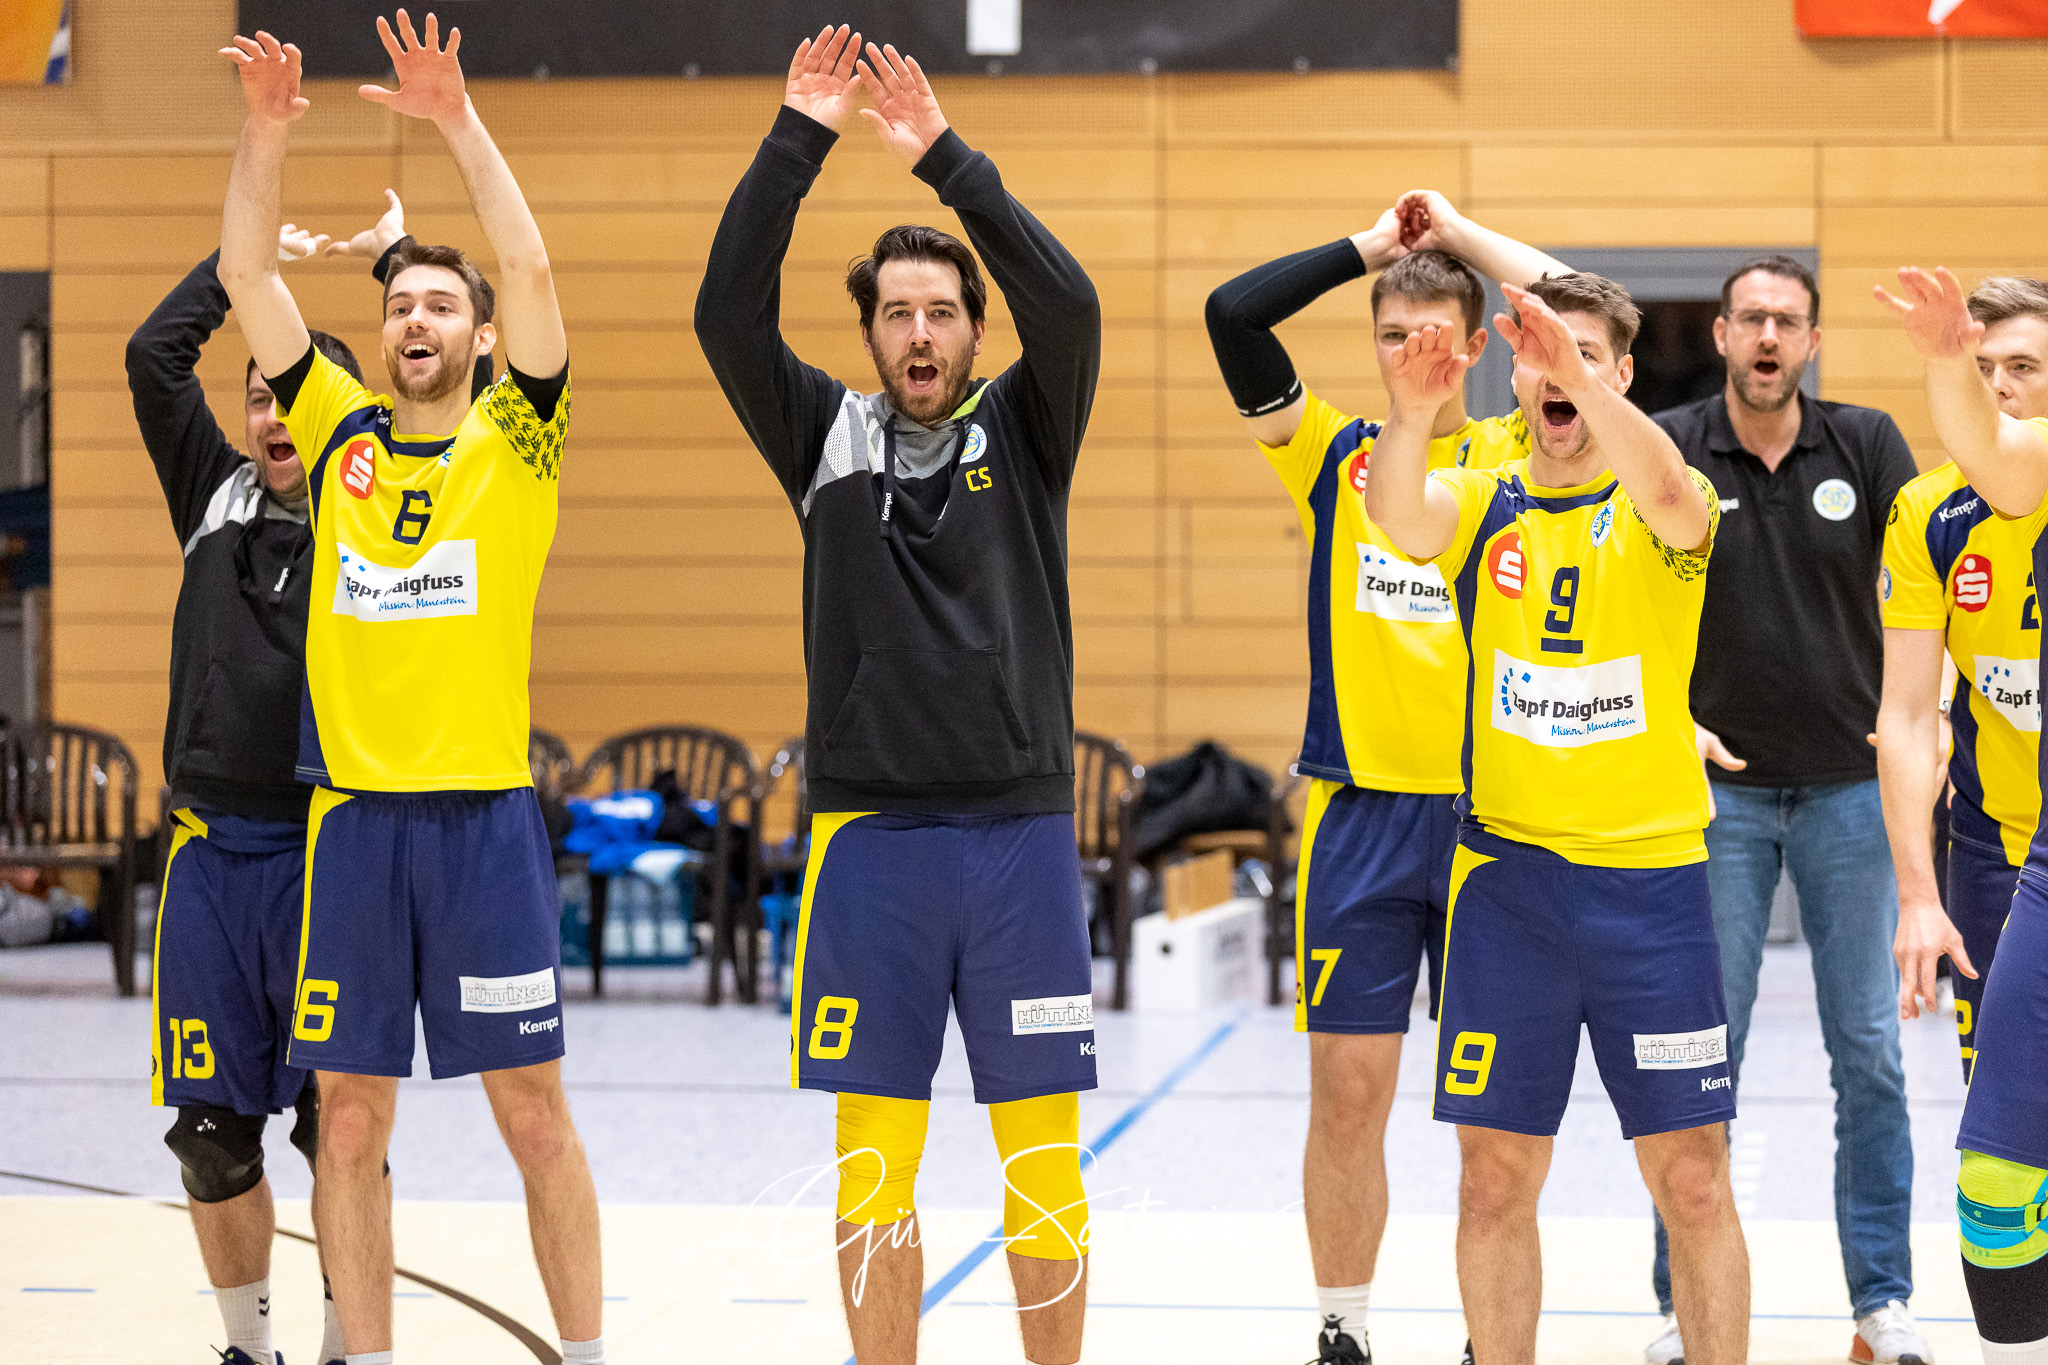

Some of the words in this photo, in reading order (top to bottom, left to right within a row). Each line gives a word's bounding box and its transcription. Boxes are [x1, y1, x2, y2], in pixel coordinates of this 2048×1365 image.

[965, 467, 992, 492] CS
[392, 490, 433, 545] 6
[881, 492, 893, 522] Kempa
[384, 574, 464, 597] aigfuss
[1366, 575, 1407, 596] Zapf
[1411, 581, 1450, 601] Daig
[416, 596, 468, 609] Mauerstein
[1544, 566, 1580, 634] 9
[1552, 694, 1634, 722] Daigfuss
[1995, 687, 2032, 708] Zapf
[1587, 717, 1637, 735] Mauerstein
[1311, 948, 1342, 1006] 7
[465, 980, 553, 1003] HÜTTINGER
[294, 979, 339, 1042] 6
[519, 1016, 559, 1035] Kempa
[808, 995, 859, 1060] 8
[170, 1018, 215, 1079] 13
[1444, 1031, 1497, 1096] 9
